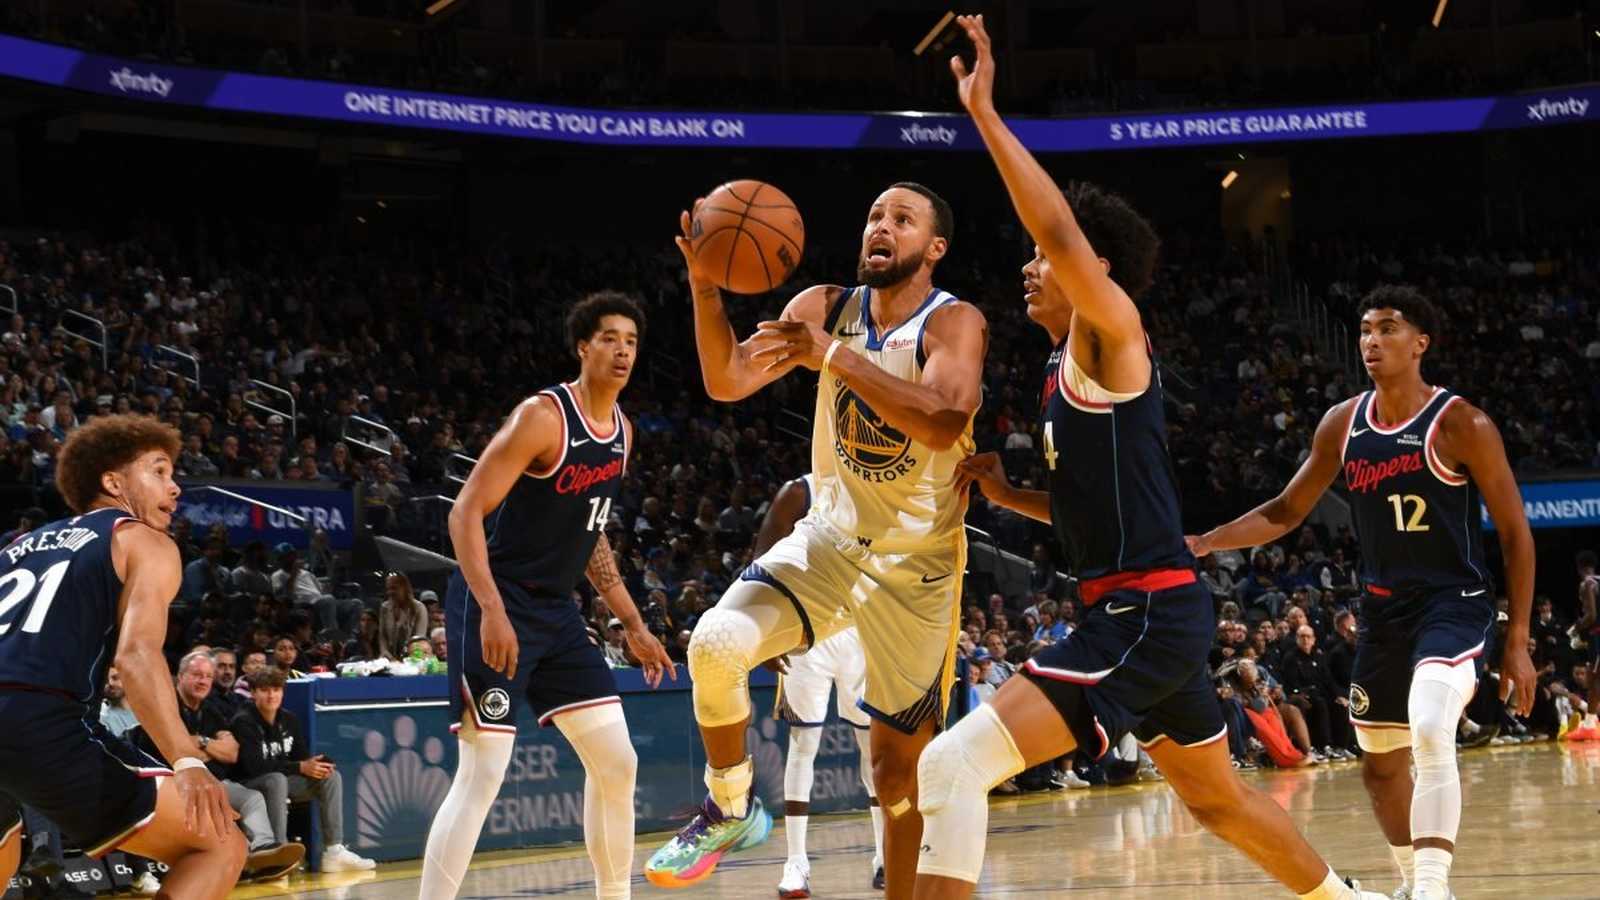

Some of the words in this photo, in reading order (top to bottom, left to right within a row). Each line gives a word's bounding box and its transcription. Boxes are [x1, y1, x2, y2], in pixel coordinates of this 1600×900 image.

[109, 67, 173, 97] xfinity
[344, 92, 391, 115] ONE
[393, 96, 491, 125] INTERNET
[493, 106, 552, 130] PRICE
[554, 113, 597, 134] YOU
[600, 117, 645, 136] CAN
[649, 118, 709, 137] BANK
[712, 119, 745, 138] ON
[1110, 124, 1123, 141] 5
[1126, 121, 1180, 140] YEAR
[1183, 116, 1241, 137] PRICE
[1245, 110, 1367, 134] GUARANTEE
[1527, 96, 1590, 121] xfinity
[900, 122, 958, 146] xfinity
[835, 440, 917, 483] WARRIORS
[1345, 451, 1424, 494] Clippers
[267, 505, 346, 531] ULTRA
[586, 497, 612, 531] 14
[1387, 494, 1430, 532] 12
[6, 527, 99, 564] PRESTON
[0, 560, 70, 635] 21
